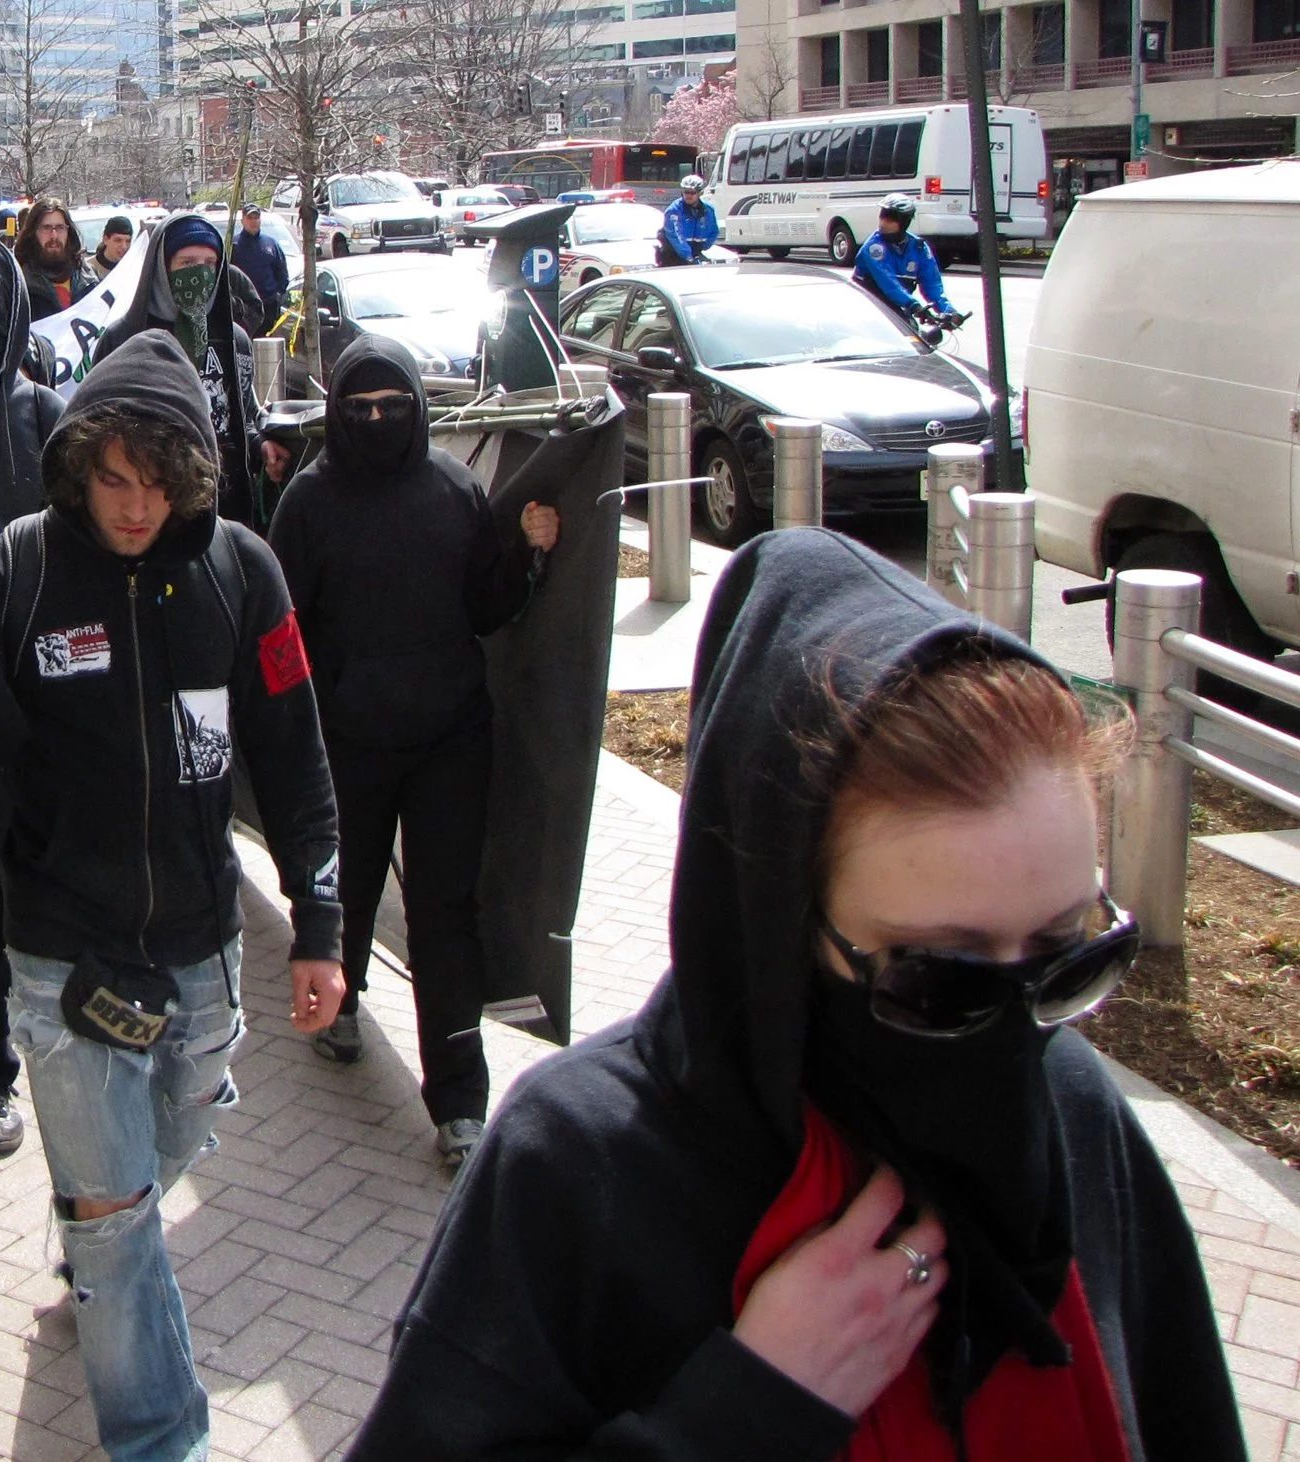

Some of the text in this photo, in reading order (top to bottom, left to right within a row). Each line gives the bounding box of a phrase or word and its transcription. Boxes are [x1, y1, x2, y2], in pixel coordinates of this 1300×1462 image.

[757, 192, 797, 204] BELTWAY
[533, 249, 553, 283] P
[65, 623, 105, 639] ANTI-FLAG
